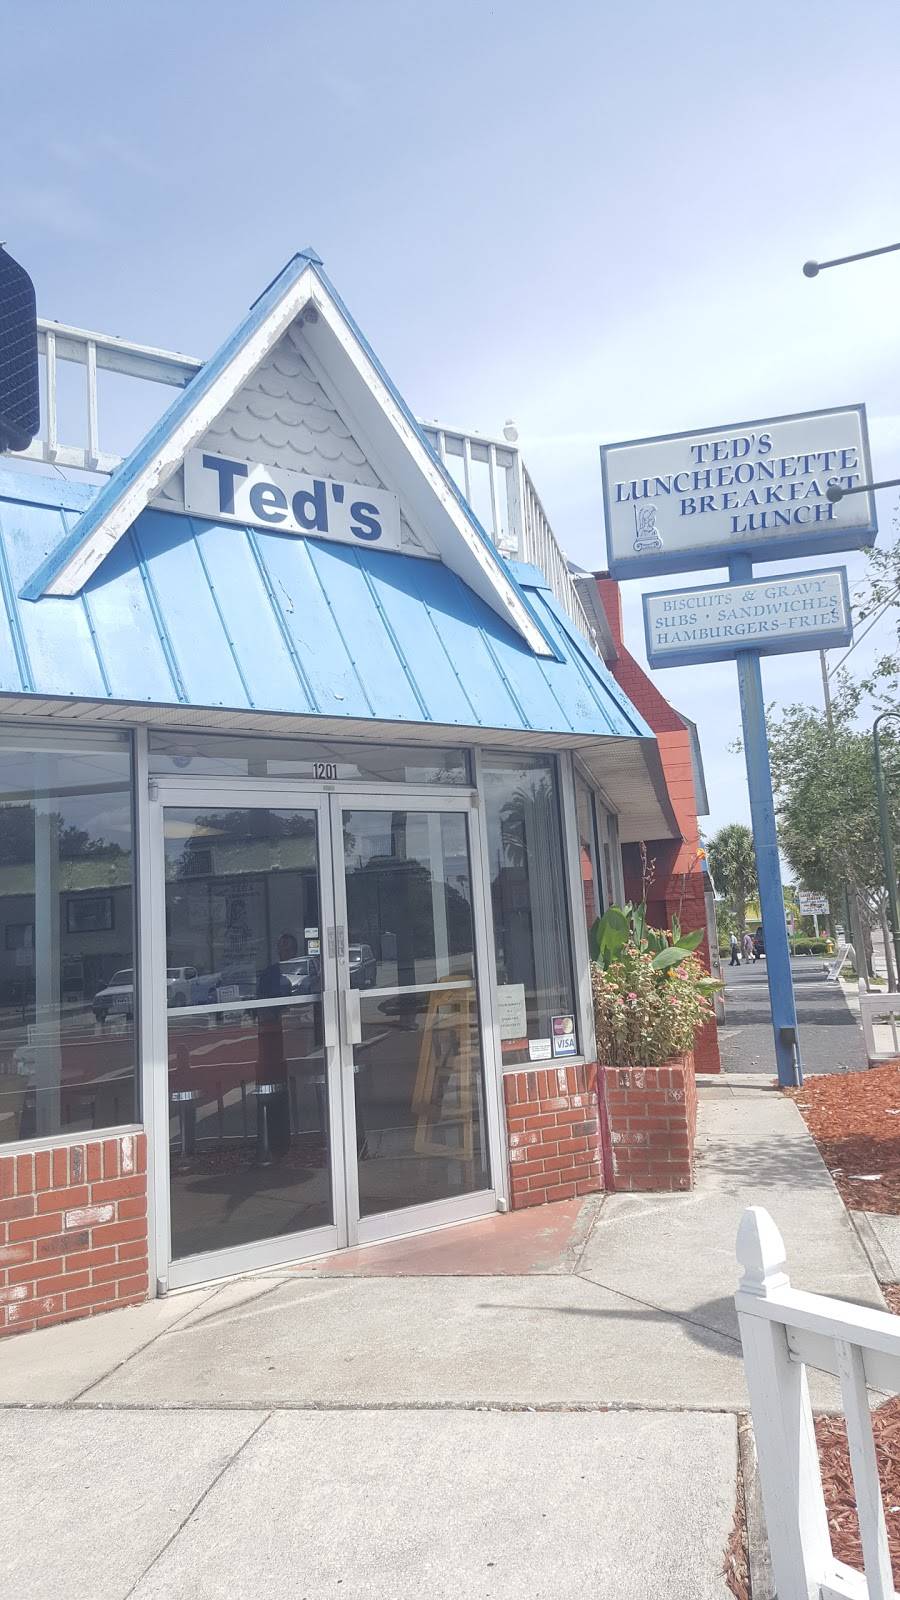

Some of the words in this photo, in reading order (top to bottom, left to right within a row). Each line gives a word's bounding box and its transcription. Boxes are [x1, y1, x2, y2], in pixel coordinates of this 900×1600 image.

[691, 433, 772, 464] TED'S
[615, 448, 858, 502] LUNCHEONETTE
[203, 454, 382, 541] Ted's
[730, 502, 837, 533] LUNCH
[663, 593, 732, 612] BISCUITS
[742, 590, 755, 601] &
[765, 580, 826, 599] GRAVY
[655, 613, 697, 629] SUBS
[718, 595, 838, 621] SANDWICHES
[313, 763, 337, 780] 1201
[557, 1039, 575, 1049] VISA
